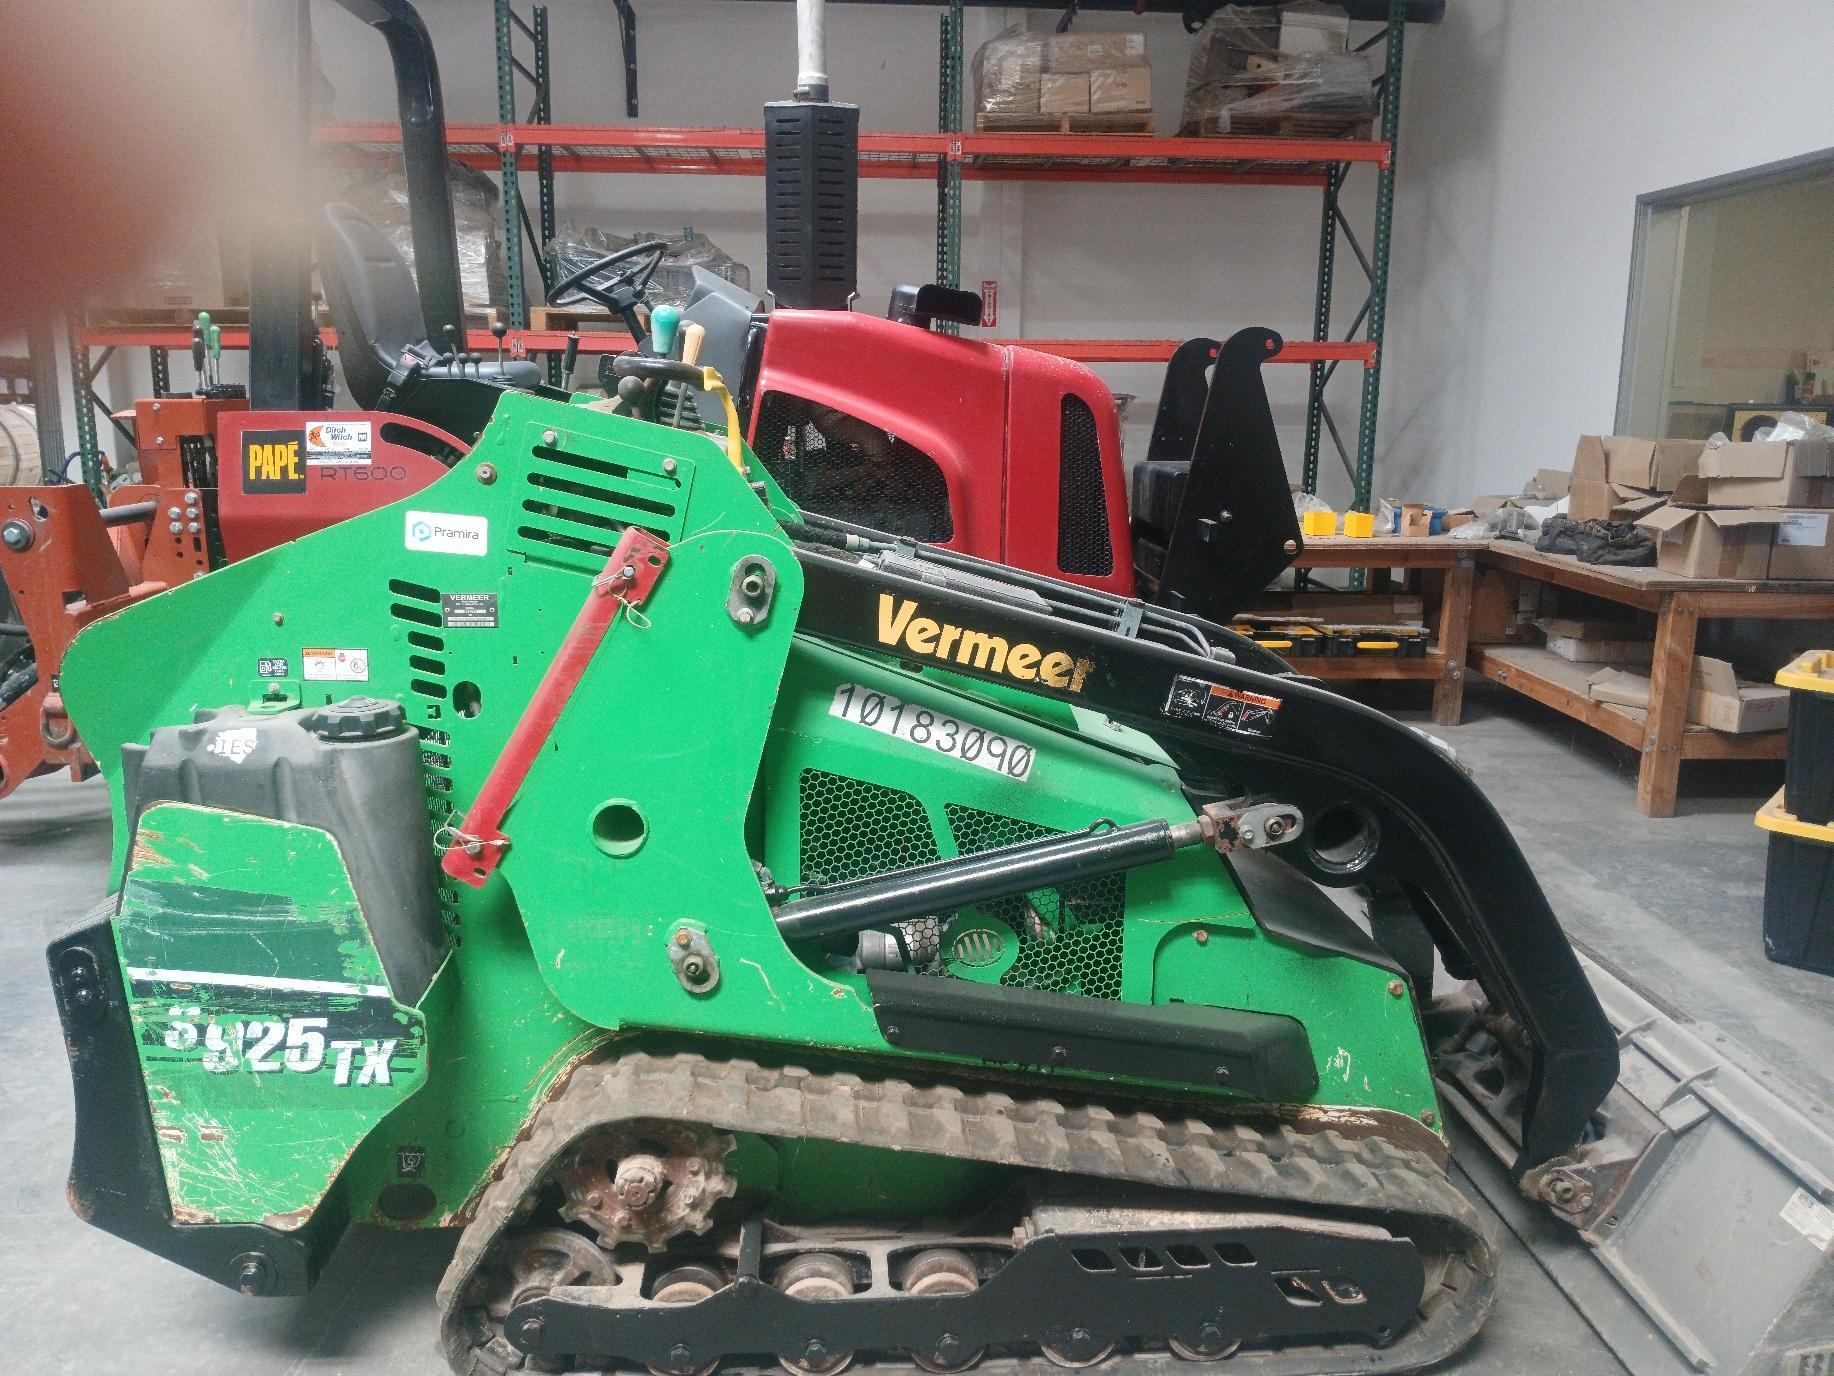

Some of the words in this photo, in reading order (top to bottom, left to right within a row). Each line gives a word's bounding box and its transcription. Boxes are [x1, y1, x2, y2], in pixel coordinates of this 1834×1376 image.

[325, 426, 347, 434] Ditch
[331, 433, 353, 441] Witch
[320, 465, 407, 481] RT600
[434, 525, 480, 541] Pramira
[876, 592, 1097, 693] Vermeer
[1233, 691, 1267, 705] WARNING
[838, 683, 1035, 779] 10183090
